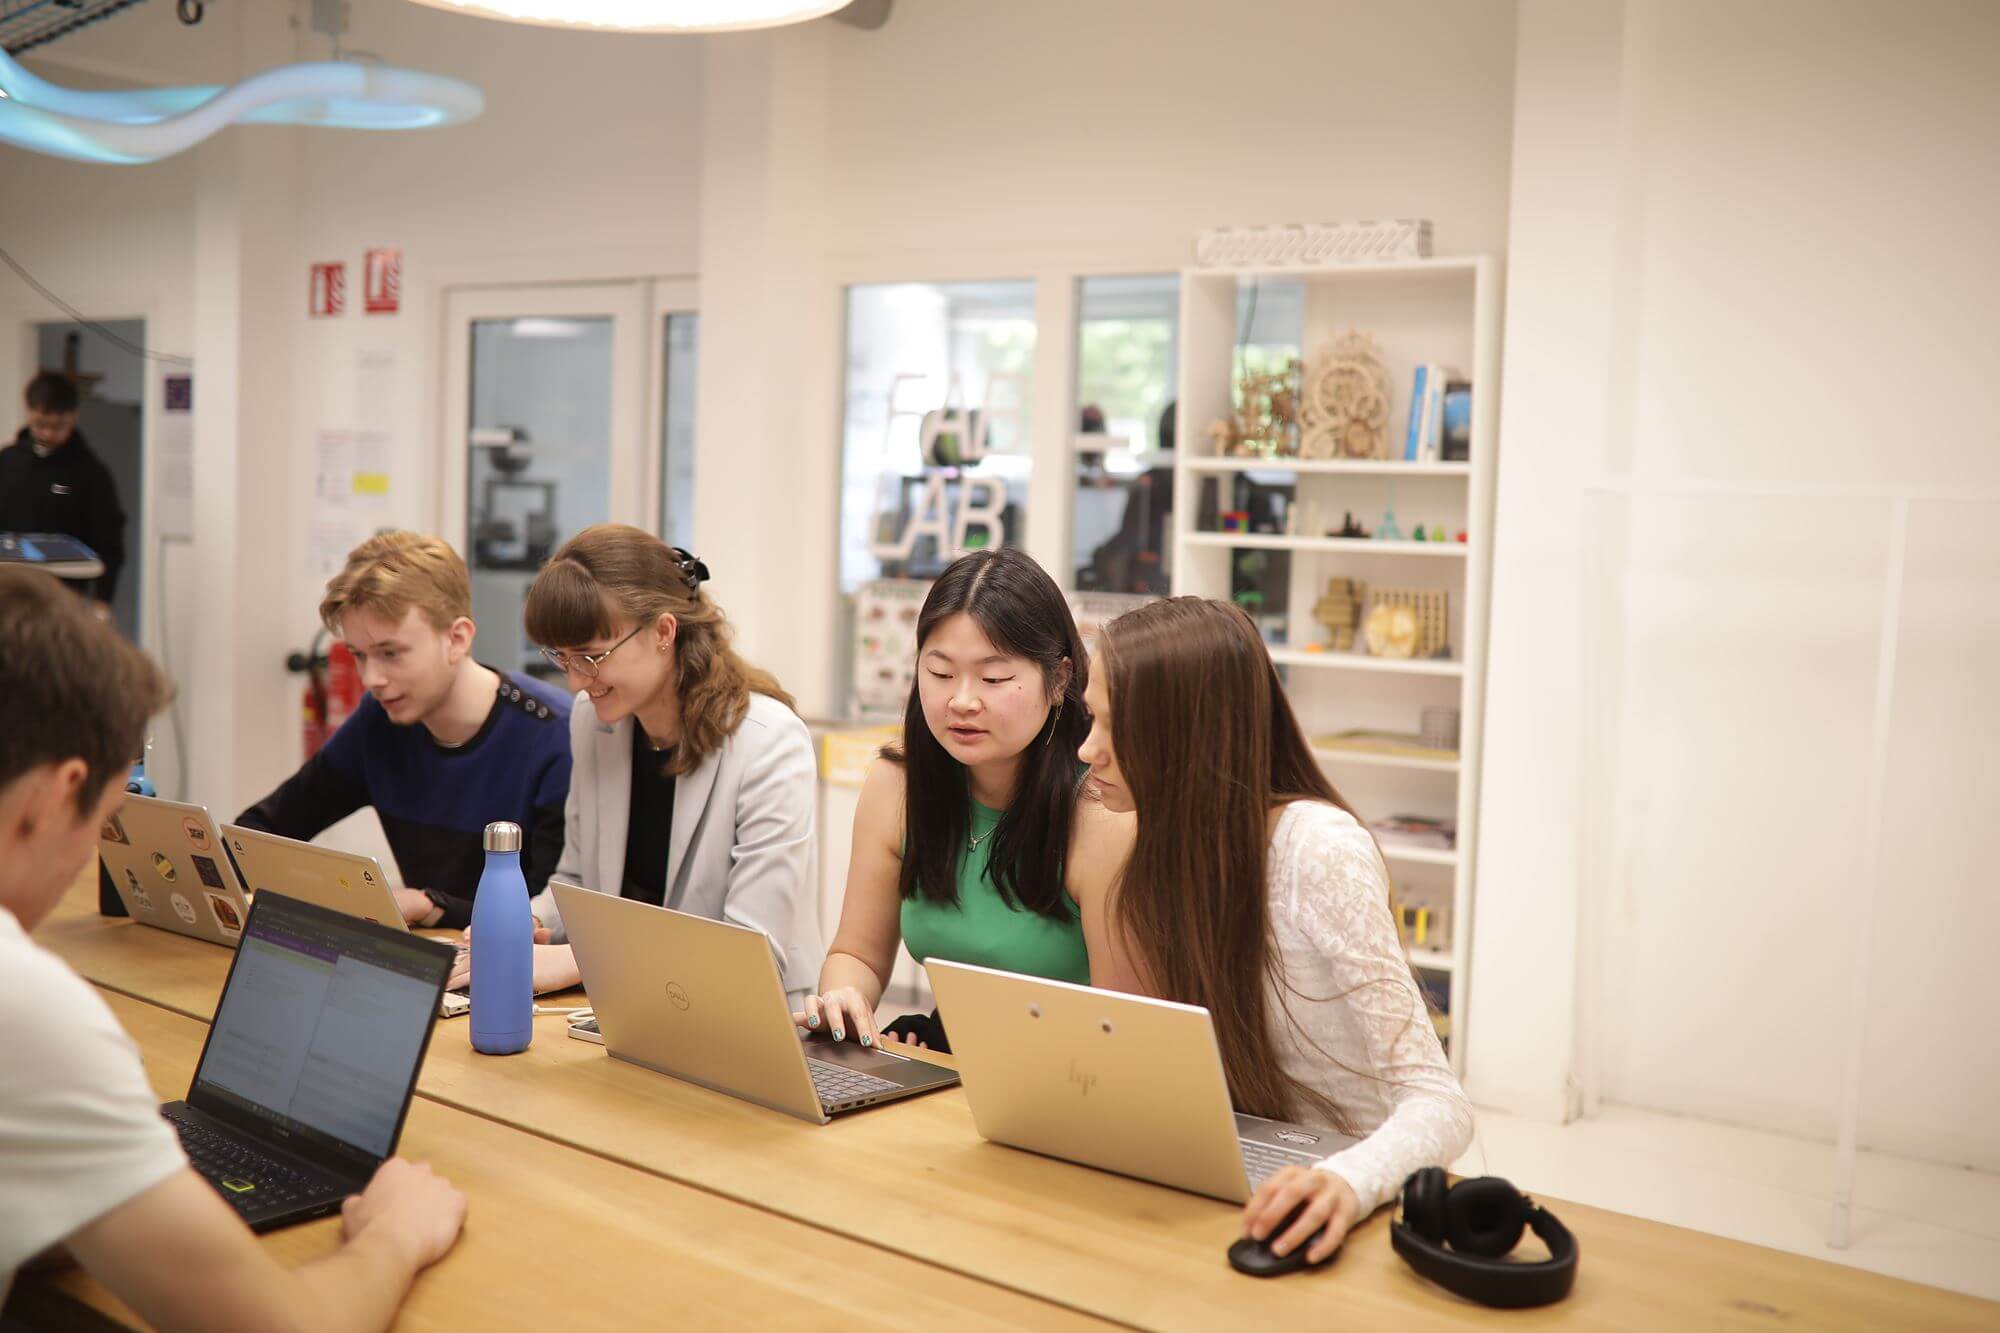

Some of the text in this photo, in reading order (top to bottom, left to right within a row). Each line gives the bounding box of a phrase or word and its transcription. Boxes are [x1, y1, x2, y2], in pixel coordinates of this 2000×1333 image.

[883, 371, 1026, 461] FAB
[868, 472, 1008, 560] LAB
[1068, 1058, 1097, 1097] hp
